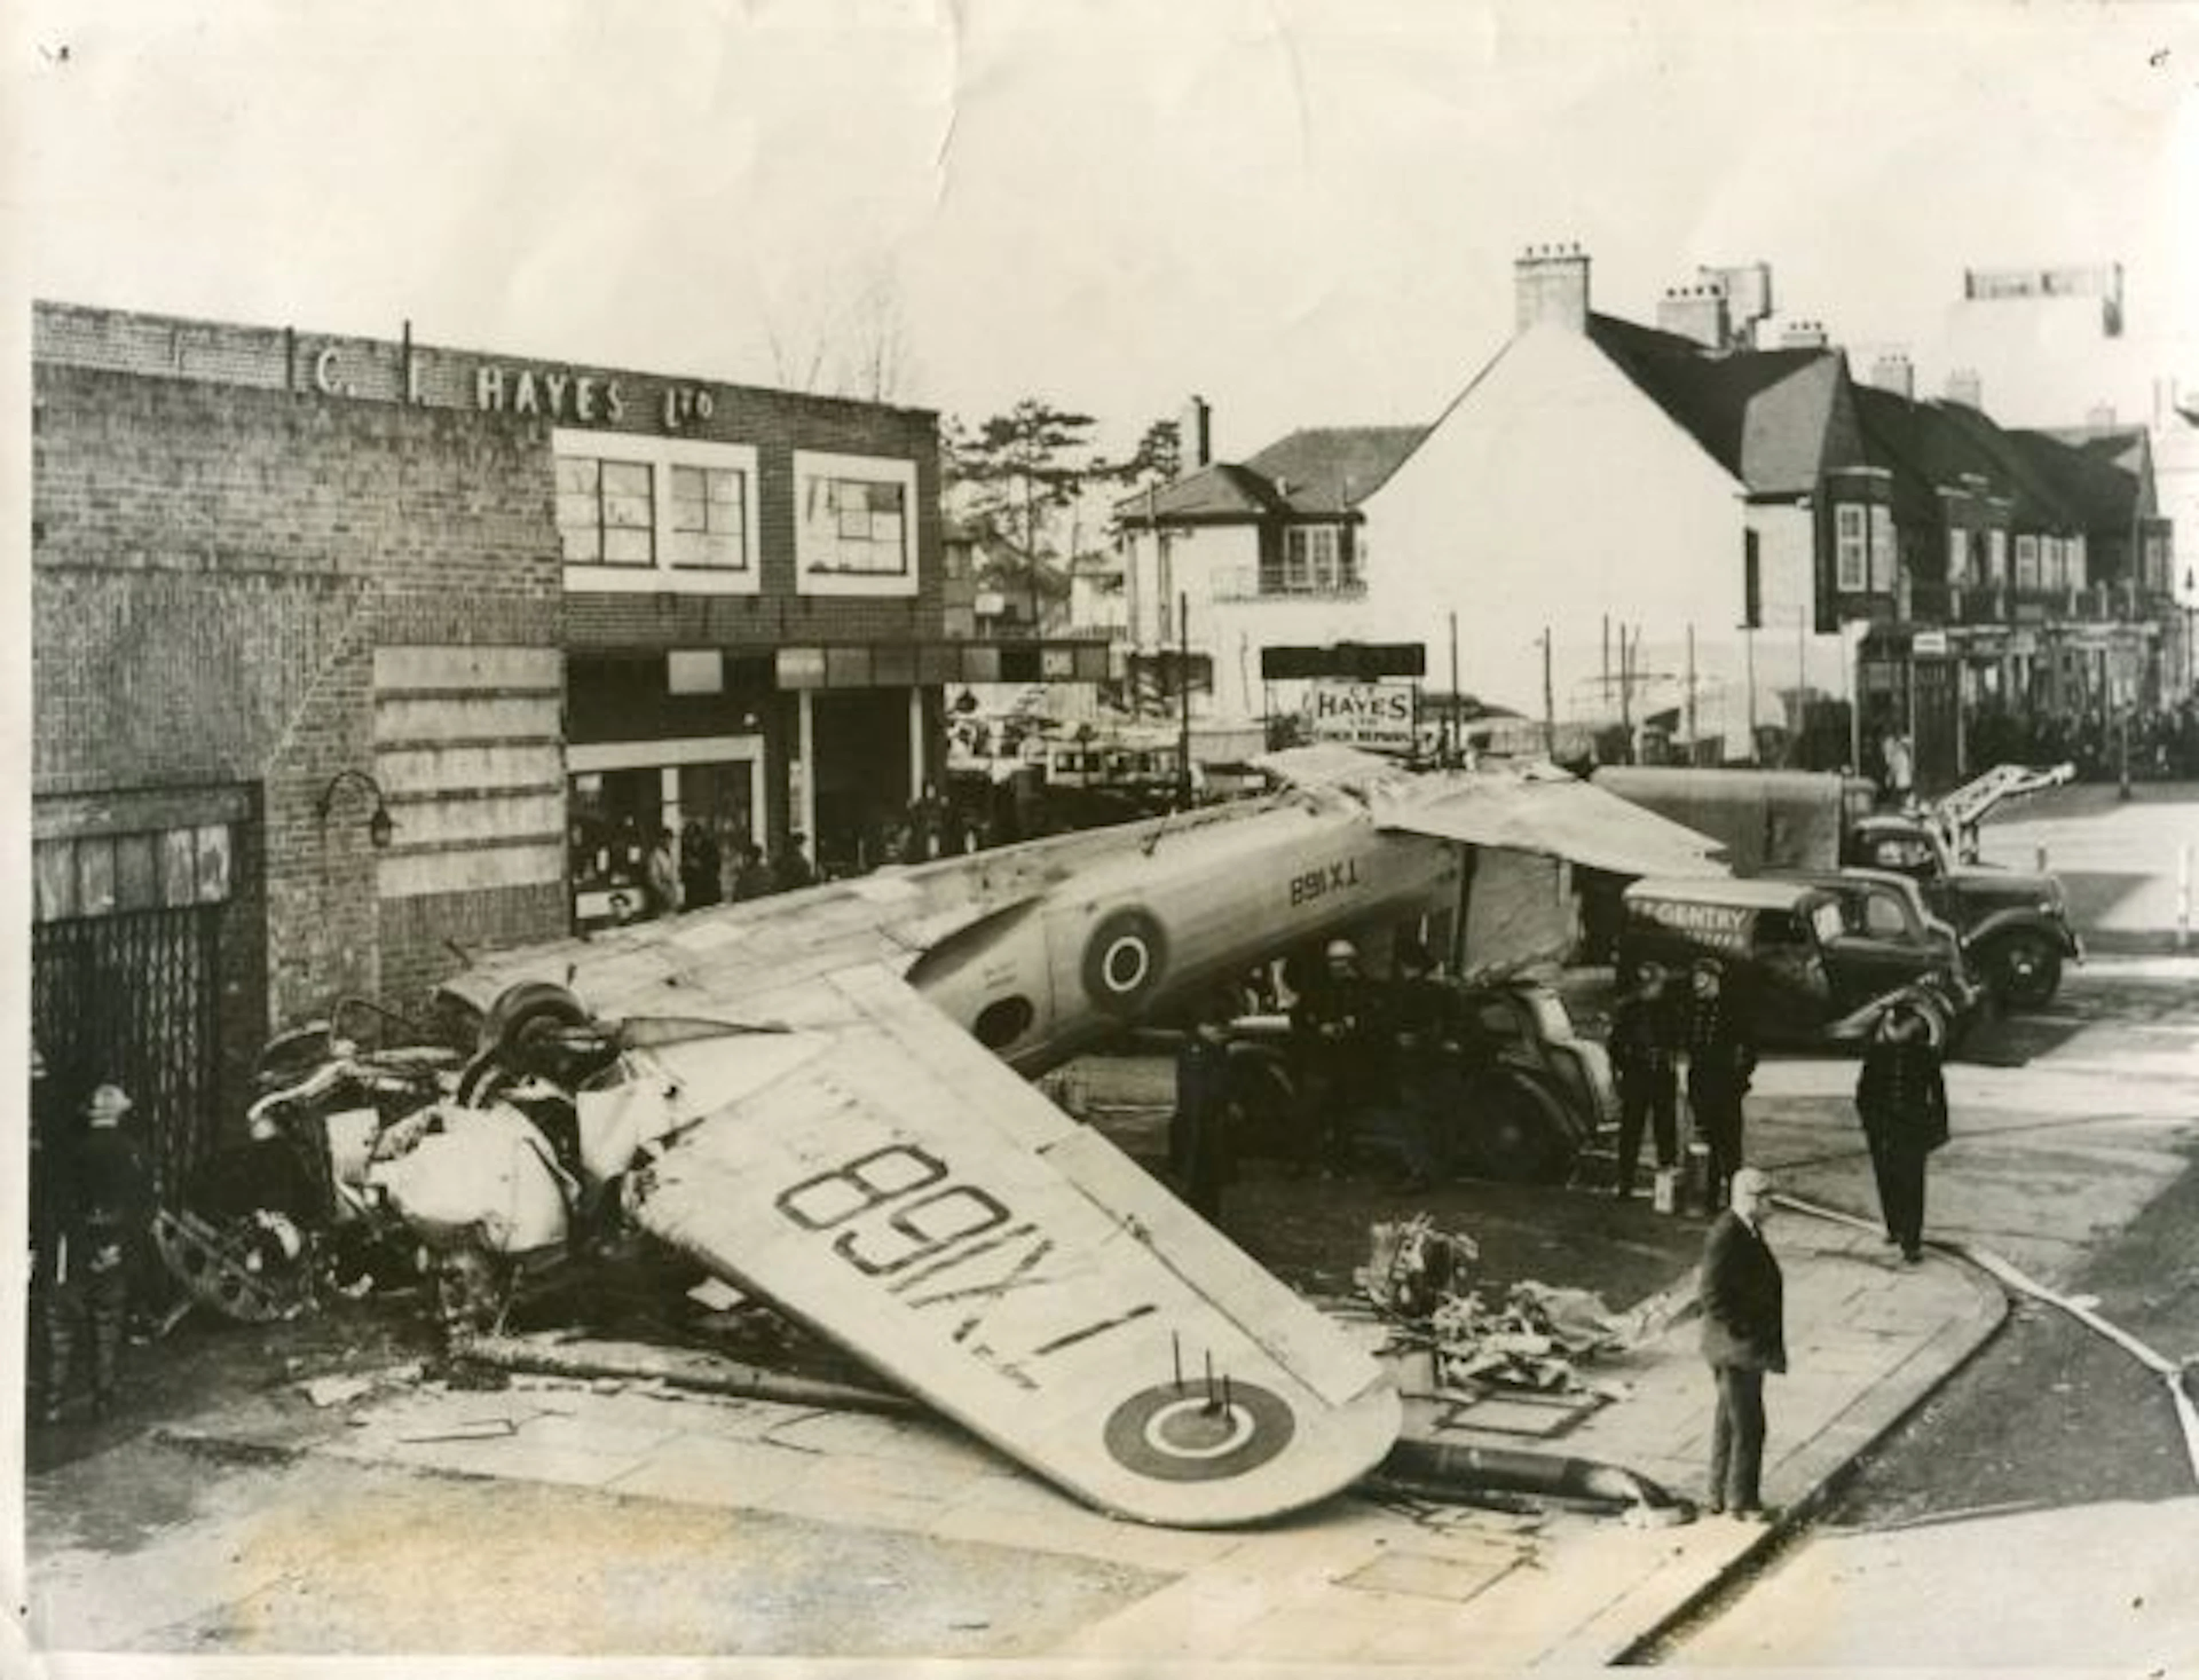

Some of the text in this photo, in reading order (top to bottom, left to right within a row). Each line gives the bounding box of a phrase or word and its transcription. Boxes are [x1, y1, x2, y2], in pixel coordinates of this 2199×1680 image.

[476, 365, 626, 423] HAYES
[1318, 692, 1408, 717] HAYES
[1291, 857, 1359, 908] TX168
[775, 1144, 1158, 1390] TX168
